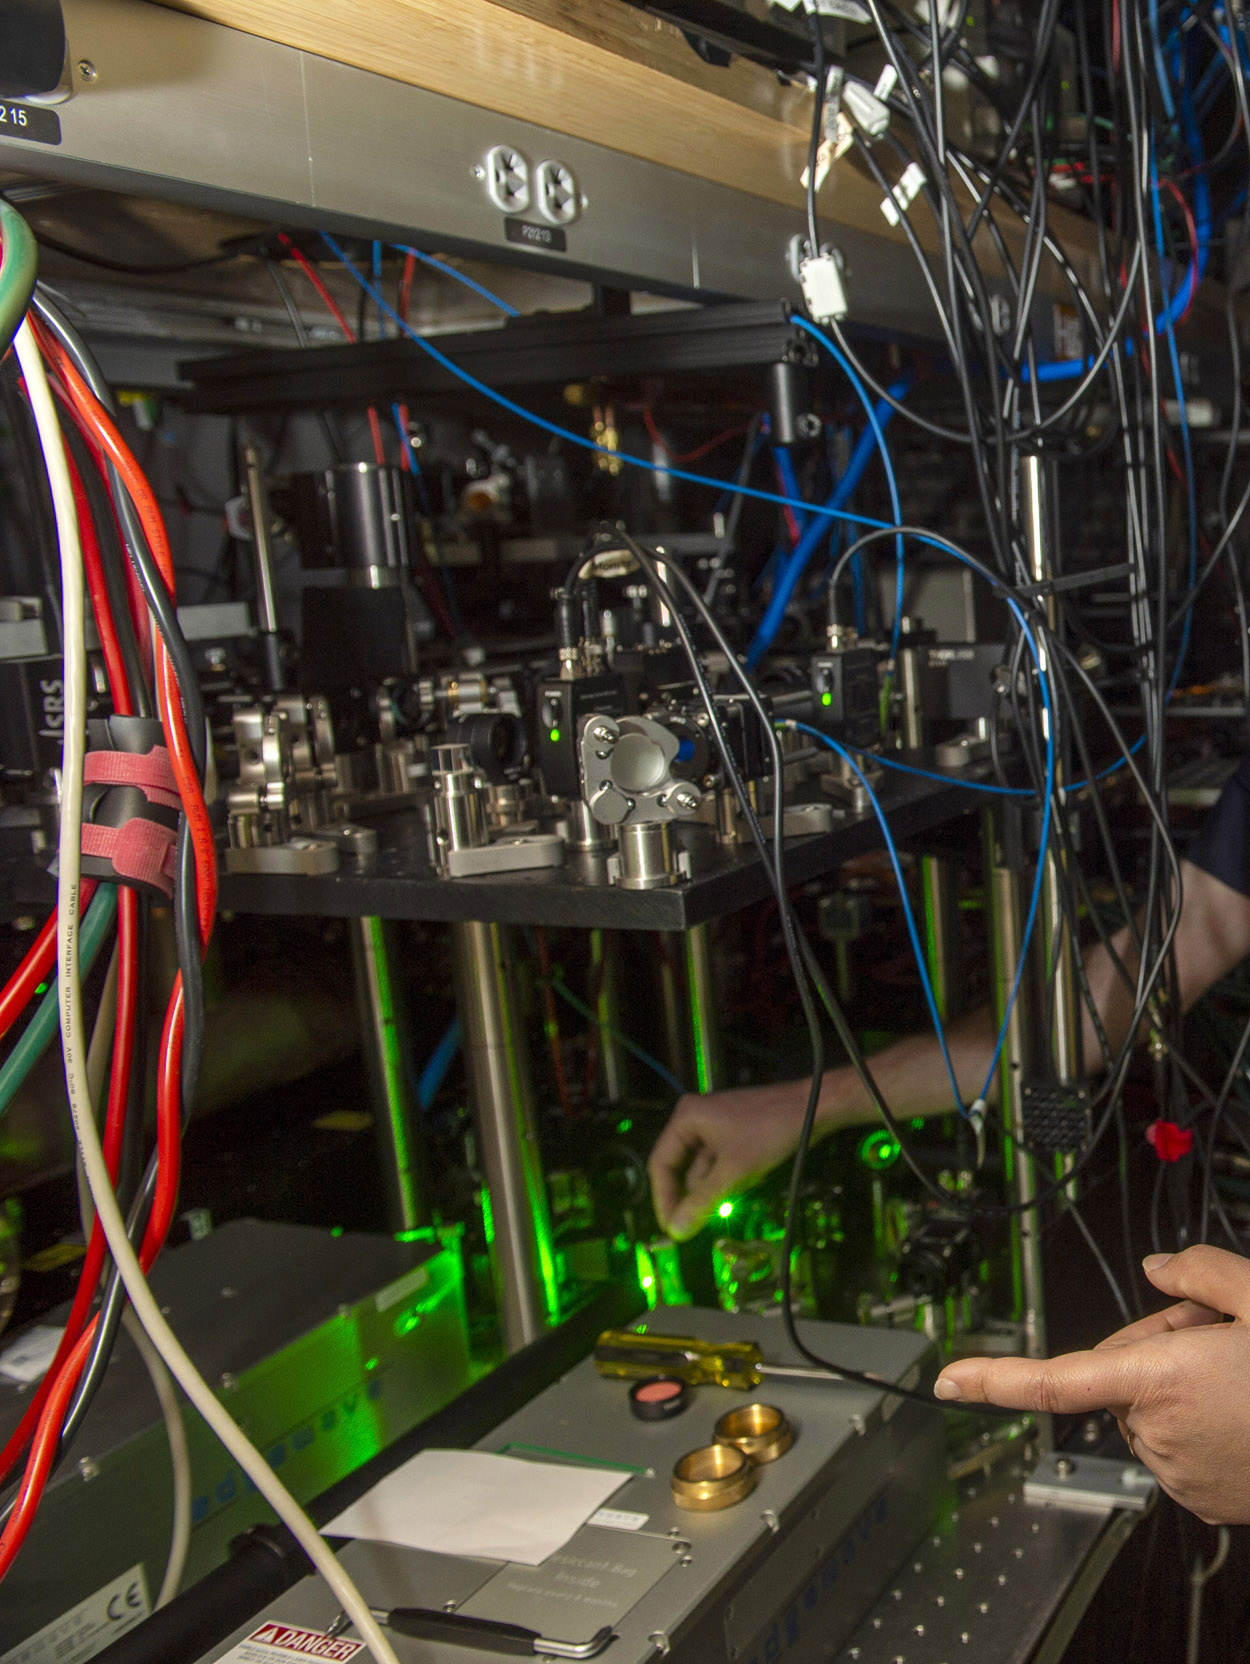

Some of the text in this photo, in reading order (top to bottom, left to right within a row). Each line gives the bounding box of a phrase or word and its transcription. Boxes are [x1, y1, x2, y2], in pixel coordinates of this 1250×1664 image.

[68, 883, 77, 915] CABLE
[65, 923, 74, 977] INTERFACE
[276, 1629, 358, 1661] DANGER
